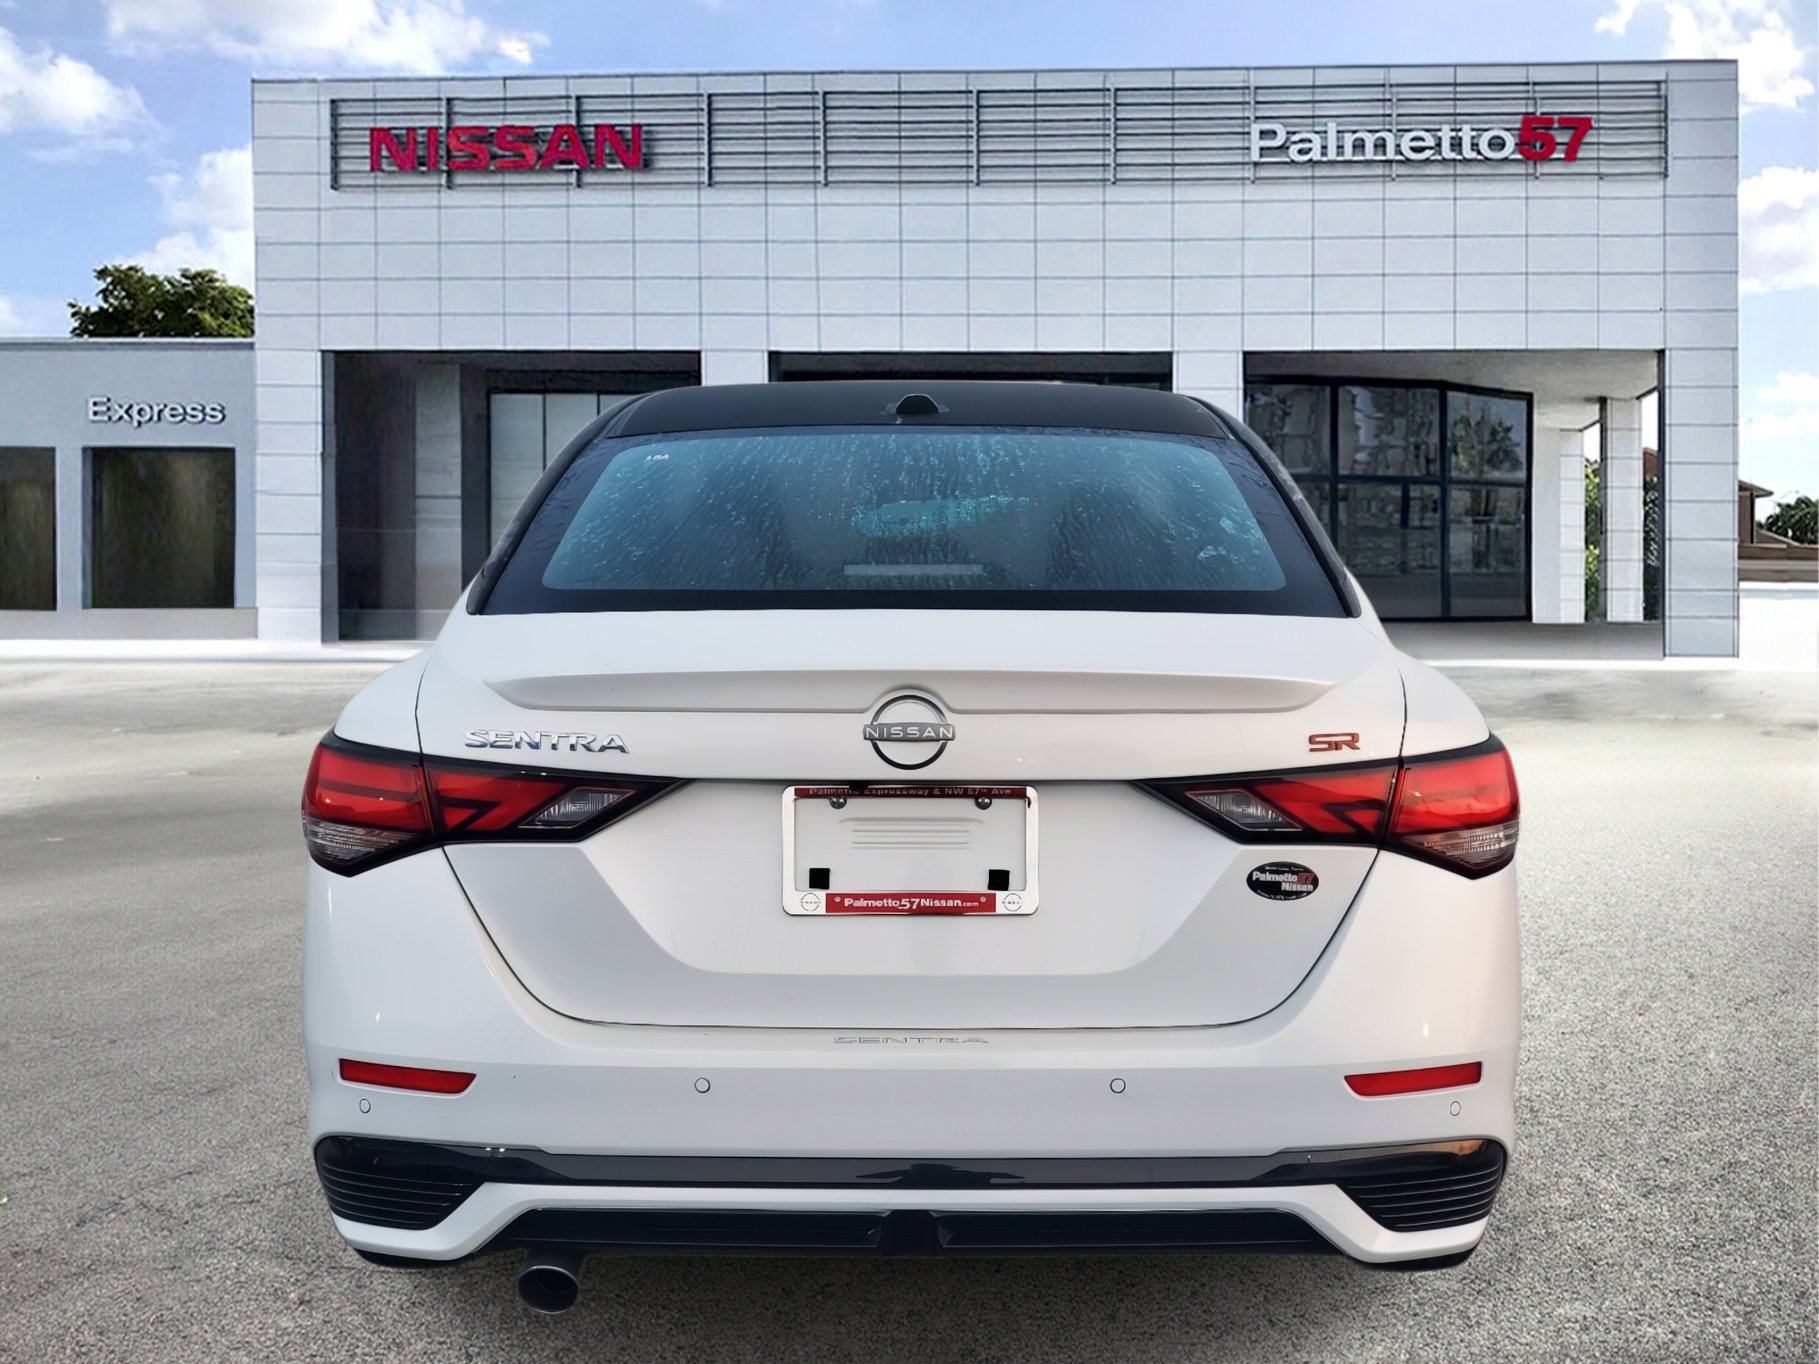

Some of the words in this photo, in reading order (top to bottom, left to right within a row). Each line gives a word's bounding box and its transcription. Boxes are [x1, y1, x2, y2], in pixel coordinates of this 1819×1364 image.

[369, 123, 644, 172] NISSAN
[88, 396, 226, 428] Express
[865, 726, 953, 739] NISSAN
[464, 728, 630, 754] SENTRA
[1308, 732, 1361, 752] SR
[944, 787, 964, 795] NW
[991, 786, 1012, 795] Ave
[1280, 881, 1314, 892] Nissan
[832, 1036, 990, 1045] SENTRA
